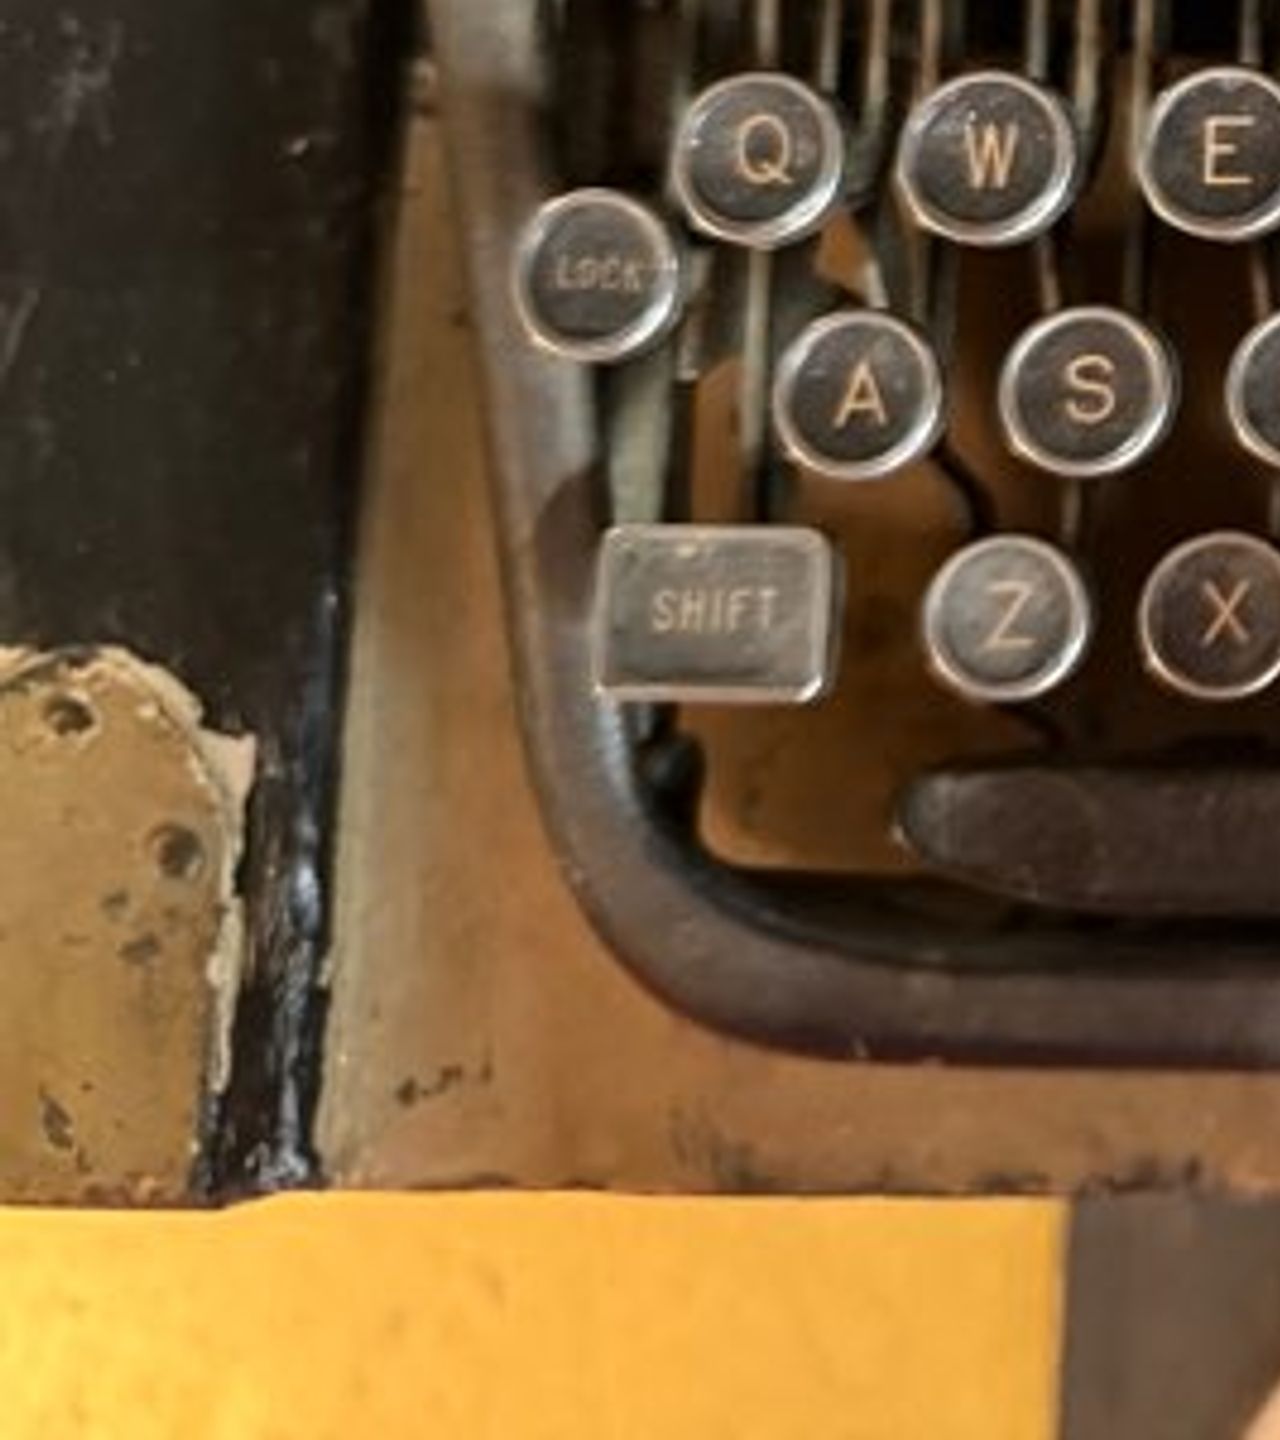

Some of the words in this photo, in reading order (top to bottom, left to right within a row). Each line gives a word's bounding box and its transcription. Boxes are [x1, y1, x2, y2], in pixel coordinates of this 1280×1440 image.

[735, 114, 792, 184] Q
[963, 120, 1020, 188] W
[1203, 115, 1255, 185] E
[834, 363, 888, 427] A
[1064, 356, 1115, 422] S
[652, 590, 777, 632] SHIFT
[984, 582, 1036, 650] Z
[1203, 581, 1249, 645] X
